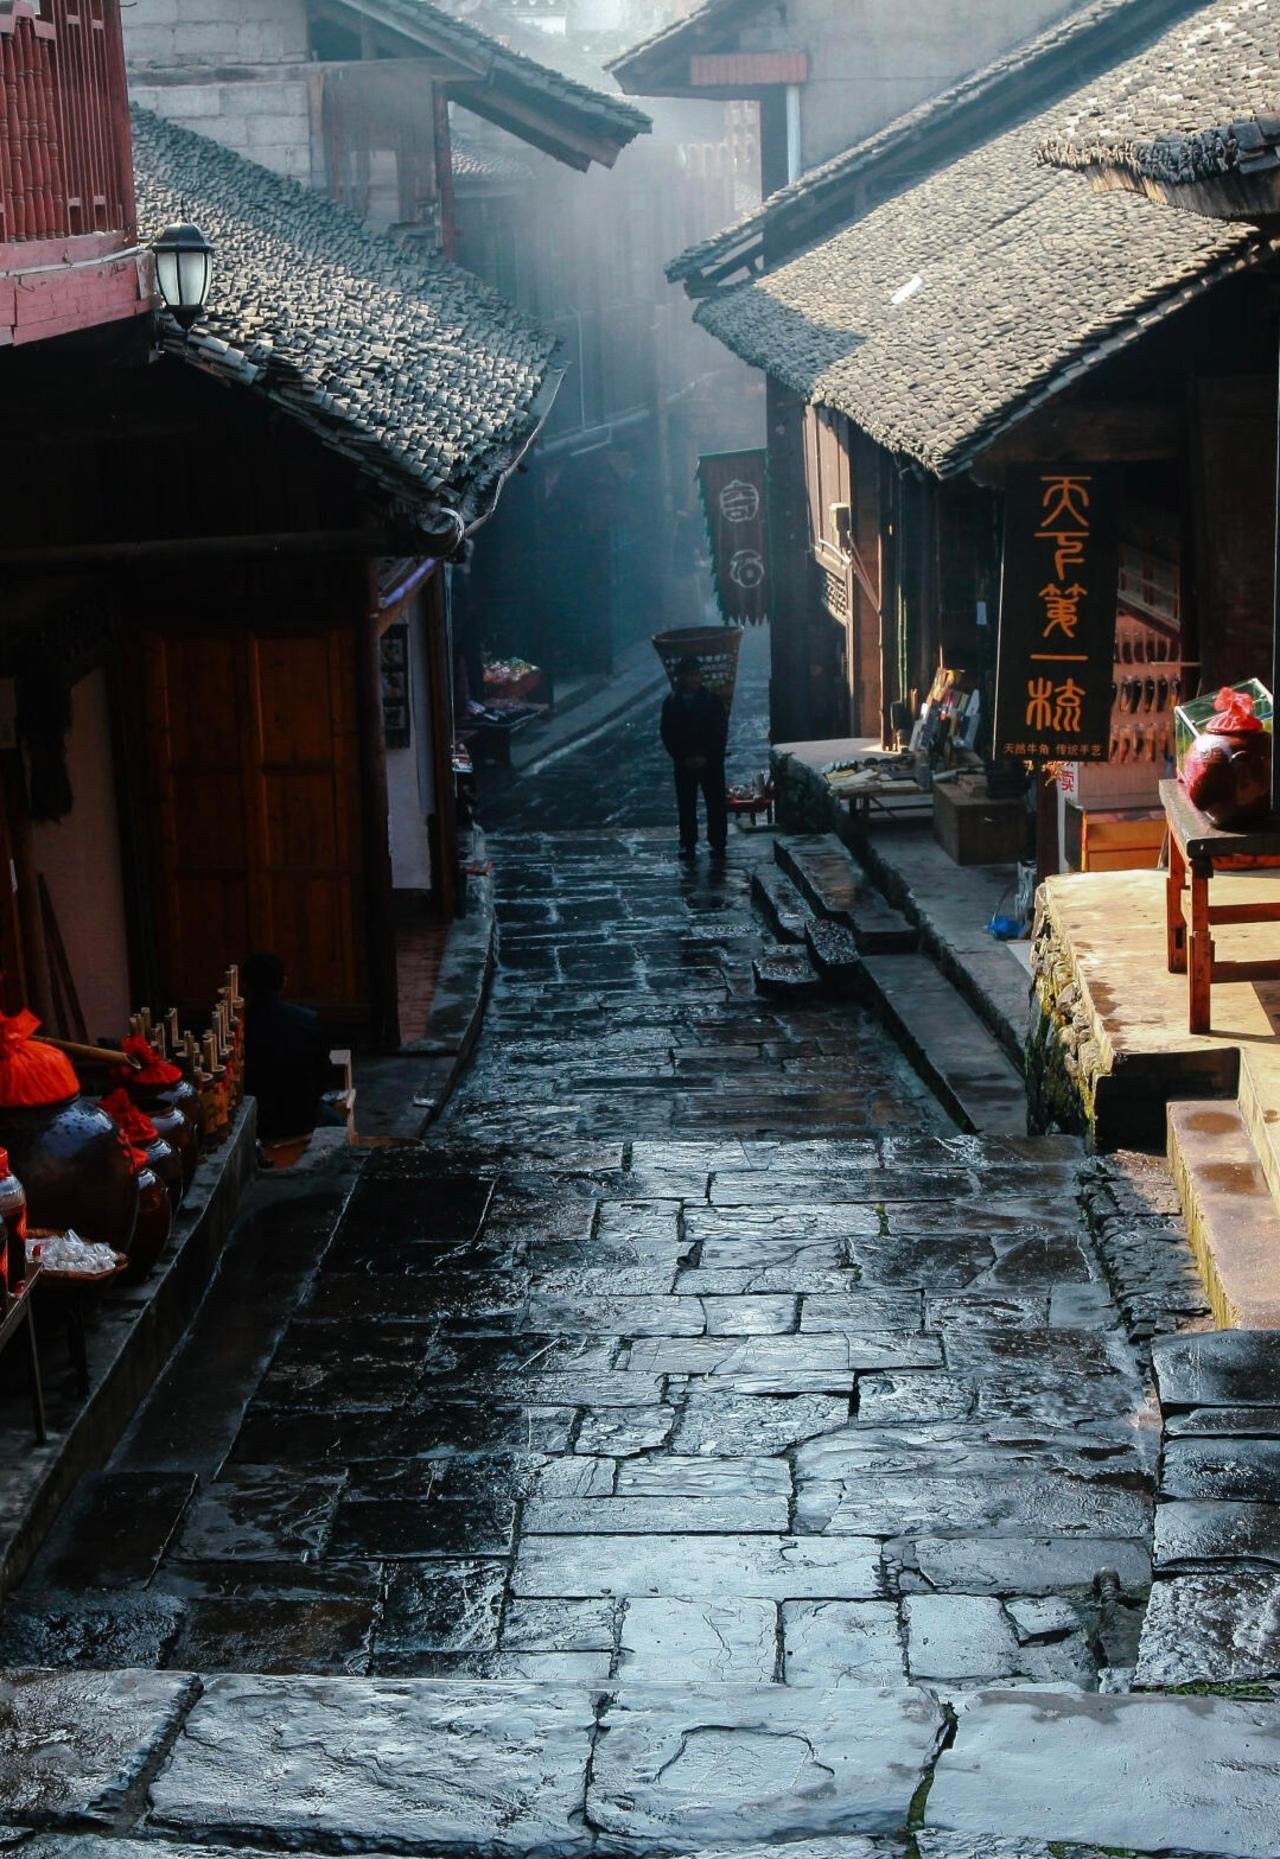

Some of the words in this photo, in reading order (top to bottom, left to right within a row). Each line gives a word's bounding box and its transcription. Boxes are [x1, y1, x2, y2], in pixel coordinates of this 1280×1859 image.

[1026, 476, 1091, 733] 天下第一梳
